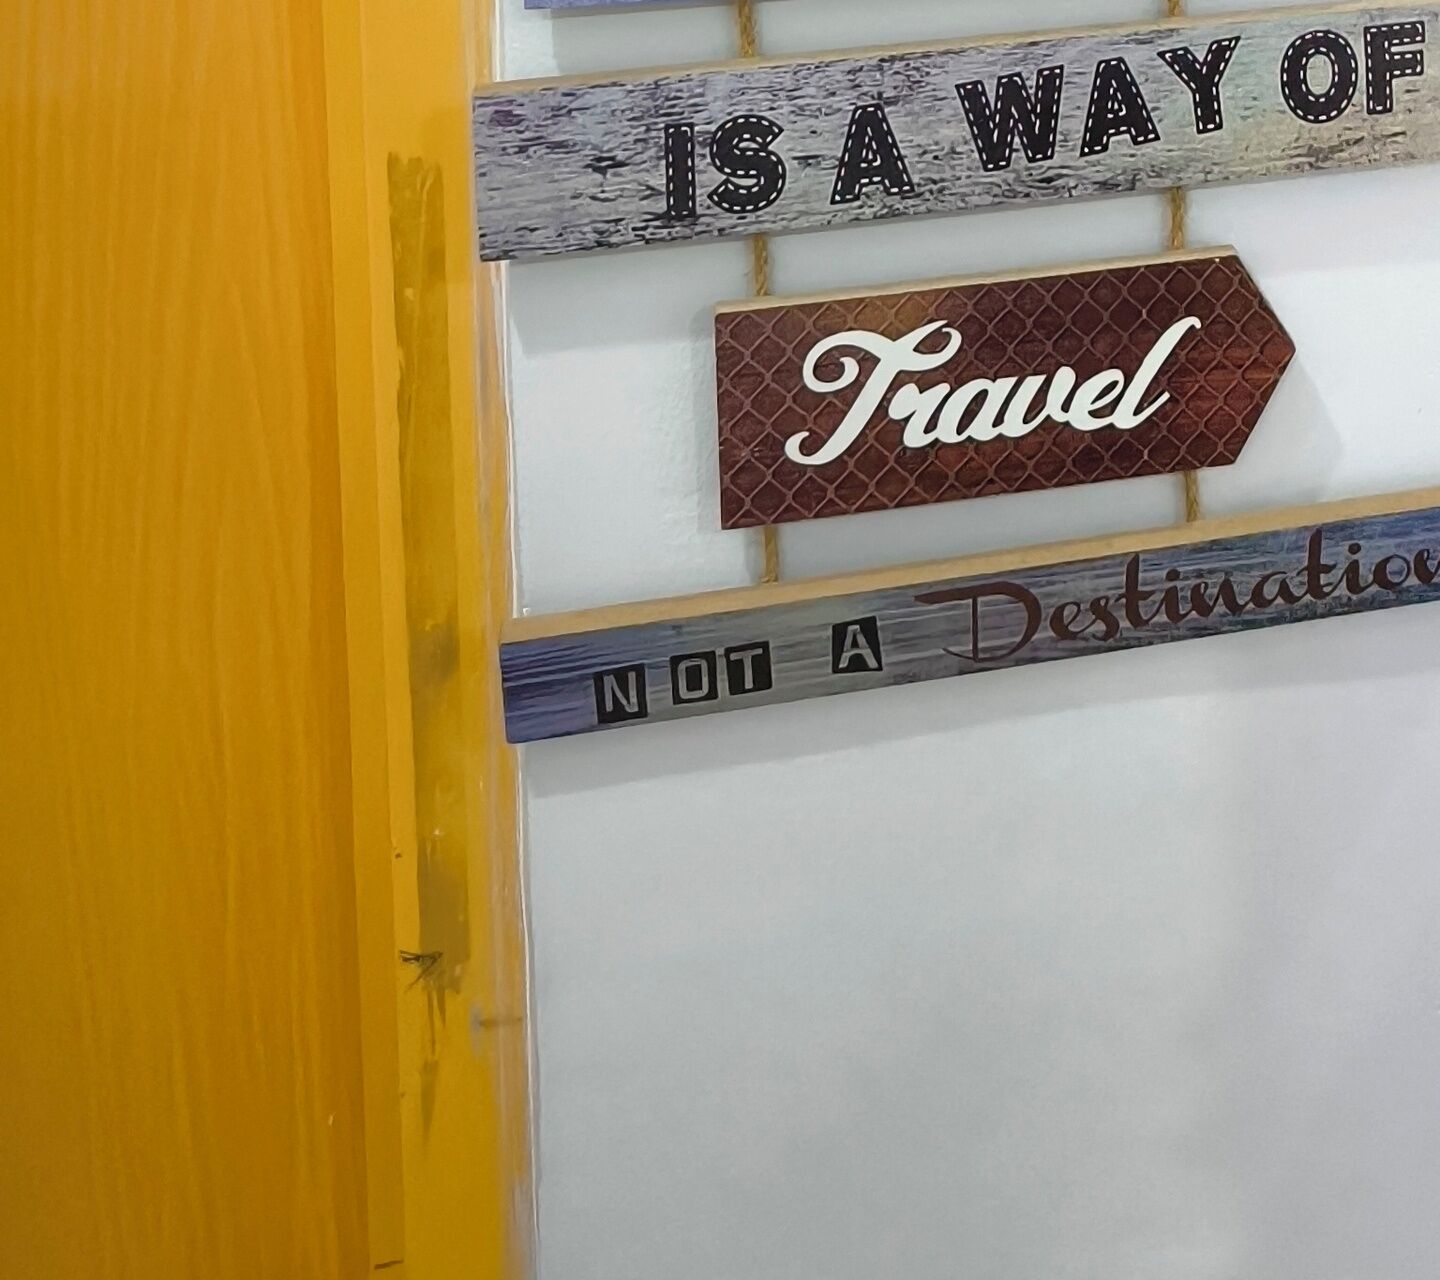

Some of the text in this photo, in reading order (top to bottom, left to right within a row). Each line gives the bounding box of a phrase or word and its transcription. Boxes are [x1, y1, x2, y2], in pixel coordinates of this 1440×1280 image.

[664, 20, 1425, 219] IS A WAY OF
[783, 315, 1203, 466] Travel
[598, 643, 772, 721] NOT
[833, 618, 881, 673] A
